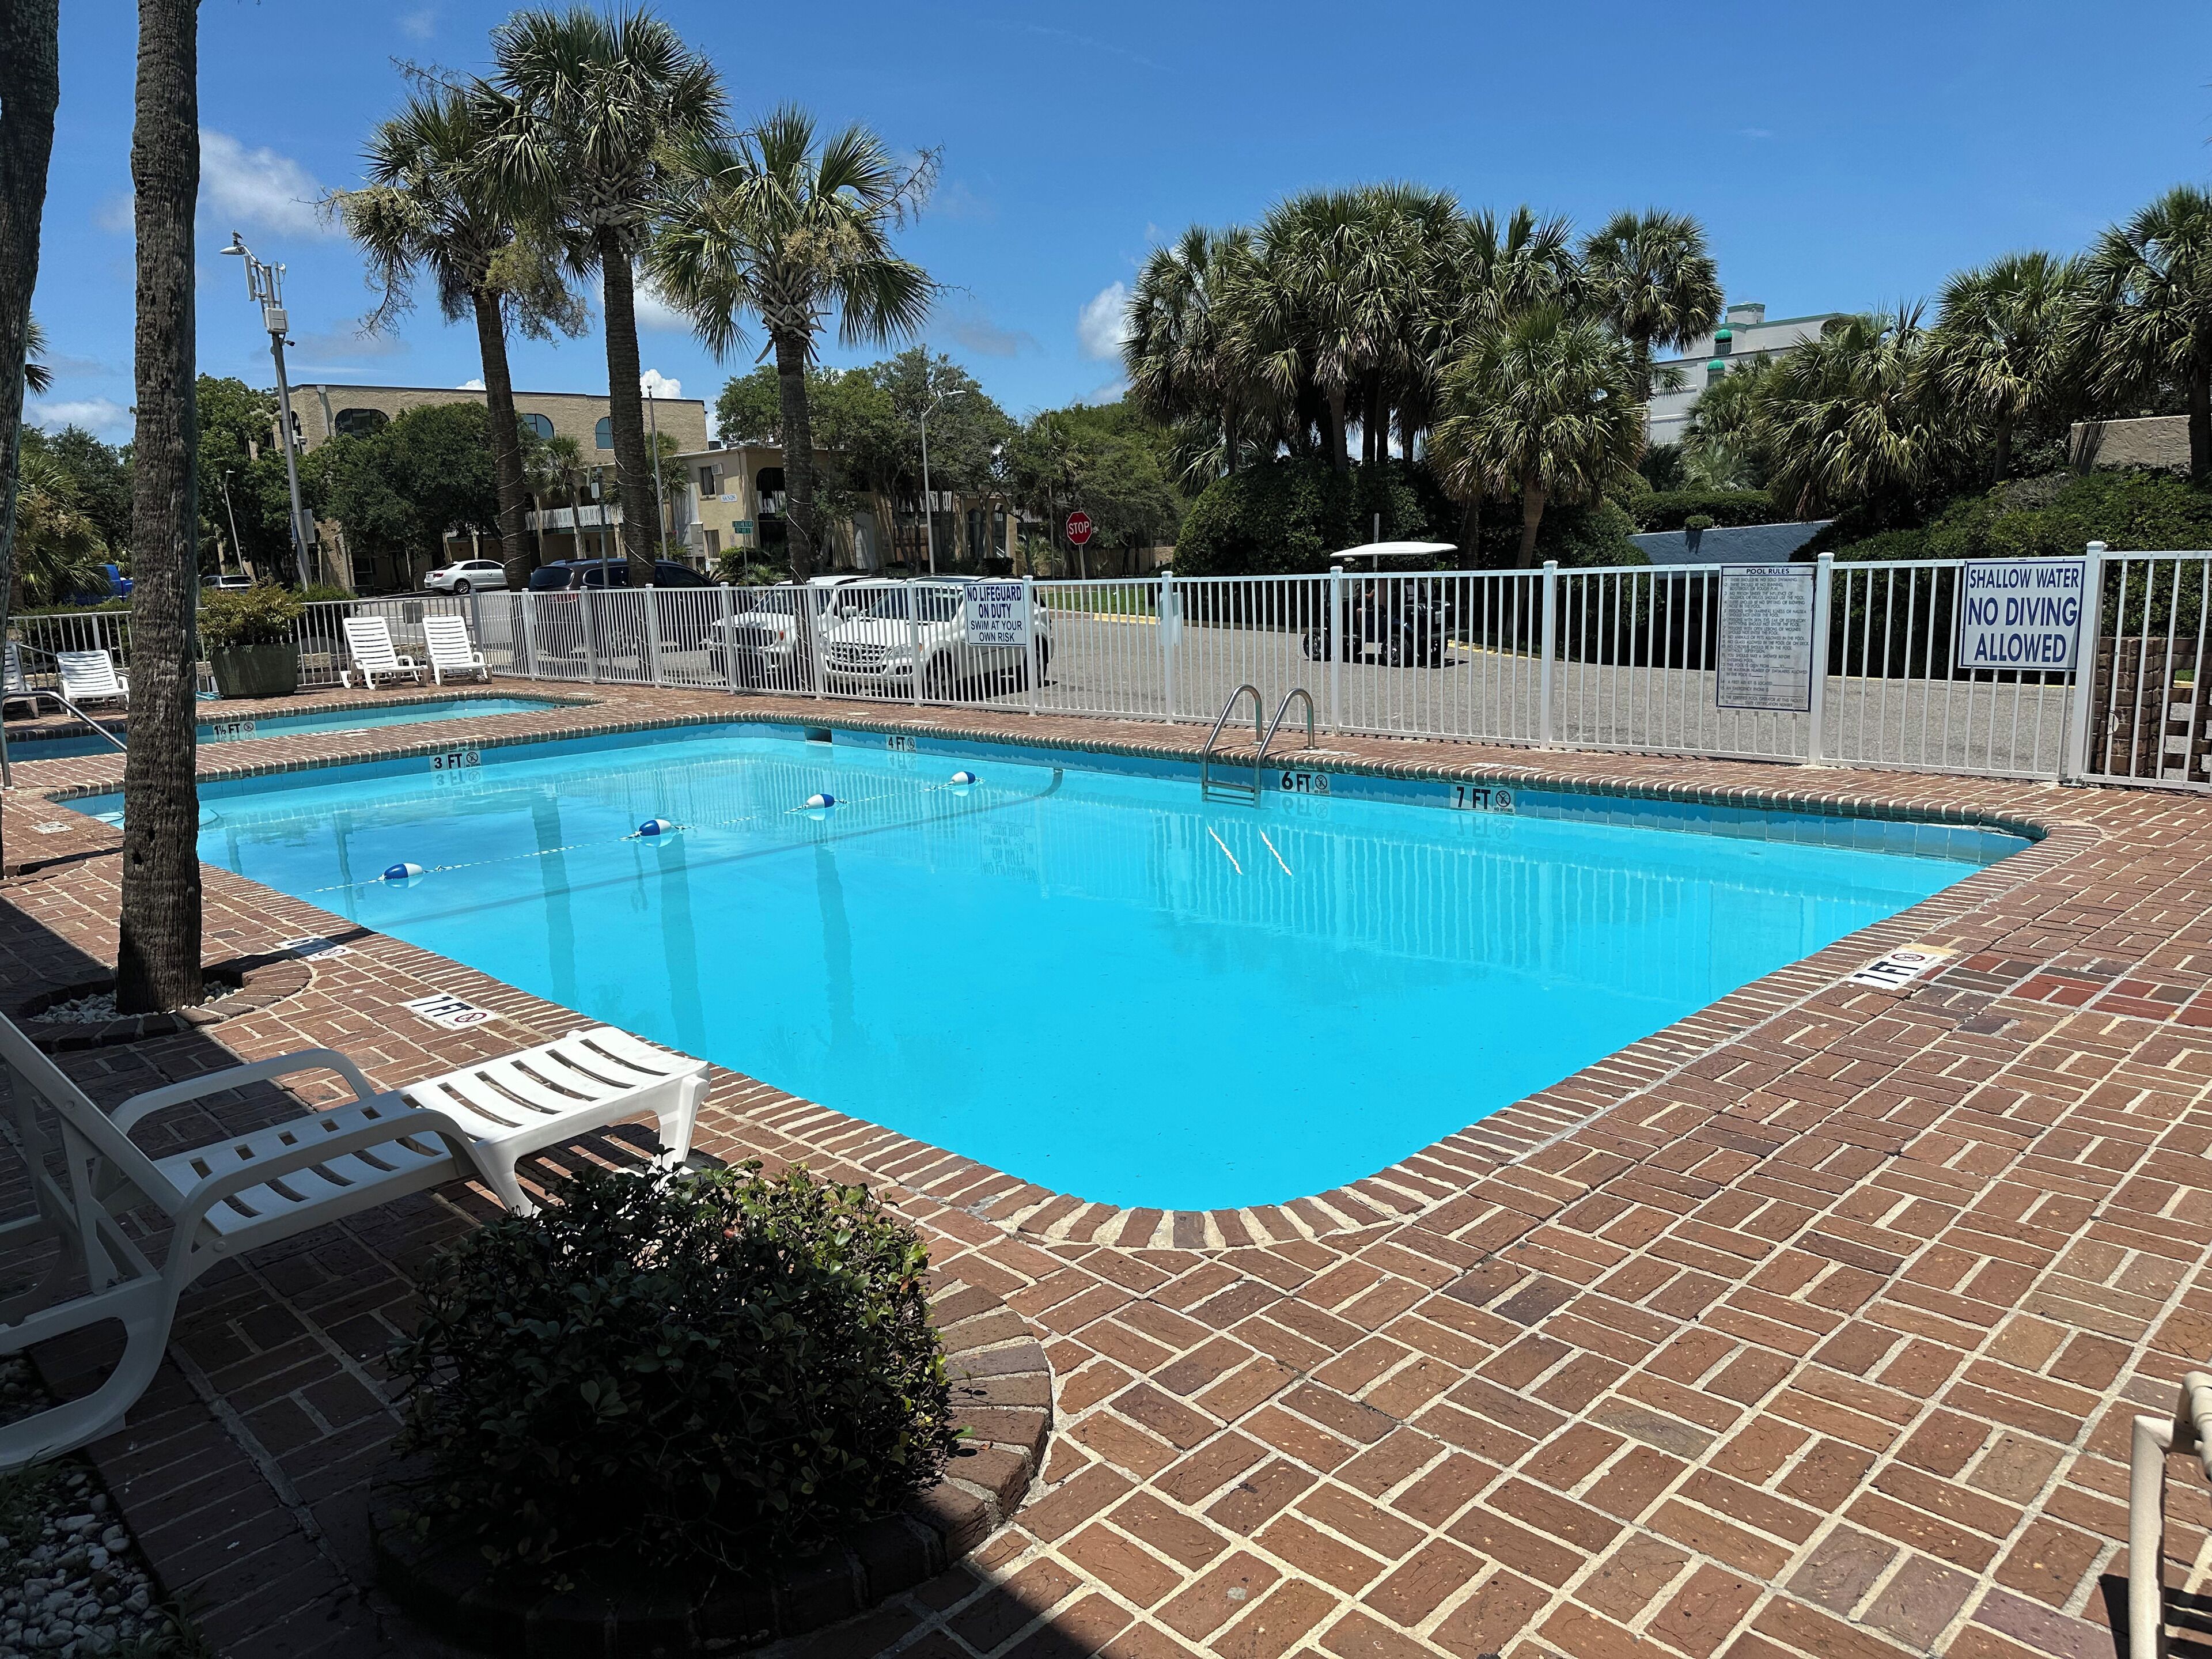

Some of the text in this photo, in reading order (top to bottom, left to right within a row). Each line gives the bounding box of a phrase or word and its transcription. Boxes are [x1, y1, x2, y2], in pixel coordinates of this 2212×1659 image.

[1069, 521, 1089, 535] STOP
[1969, 568, 2079, 588] SHALLOW WATER
[967, 586, 1021, 601] NO LIFEGUARD
[979, 603, 1011, 618] ON DUTY
[1968, 597, 2078, 626] NO DIVING
[971, 620, 1022, 630] SWIM AT YOUR
[979, 632, 1014, 642] OWN RISK
[1974, 633, 2066, 662] ALLOWED
[228, 724, 240, 733] FT
[888, 736, 905, 751] 4 FT
[434, 753, 463, 769] 3 FT
[1282, 771, 1311, 793] 6 FT
[1457, 786, 1491, 810] 7 FT
[1868, 961, 1920, 976] FT
[424, 1002, 474, 1017] FT
